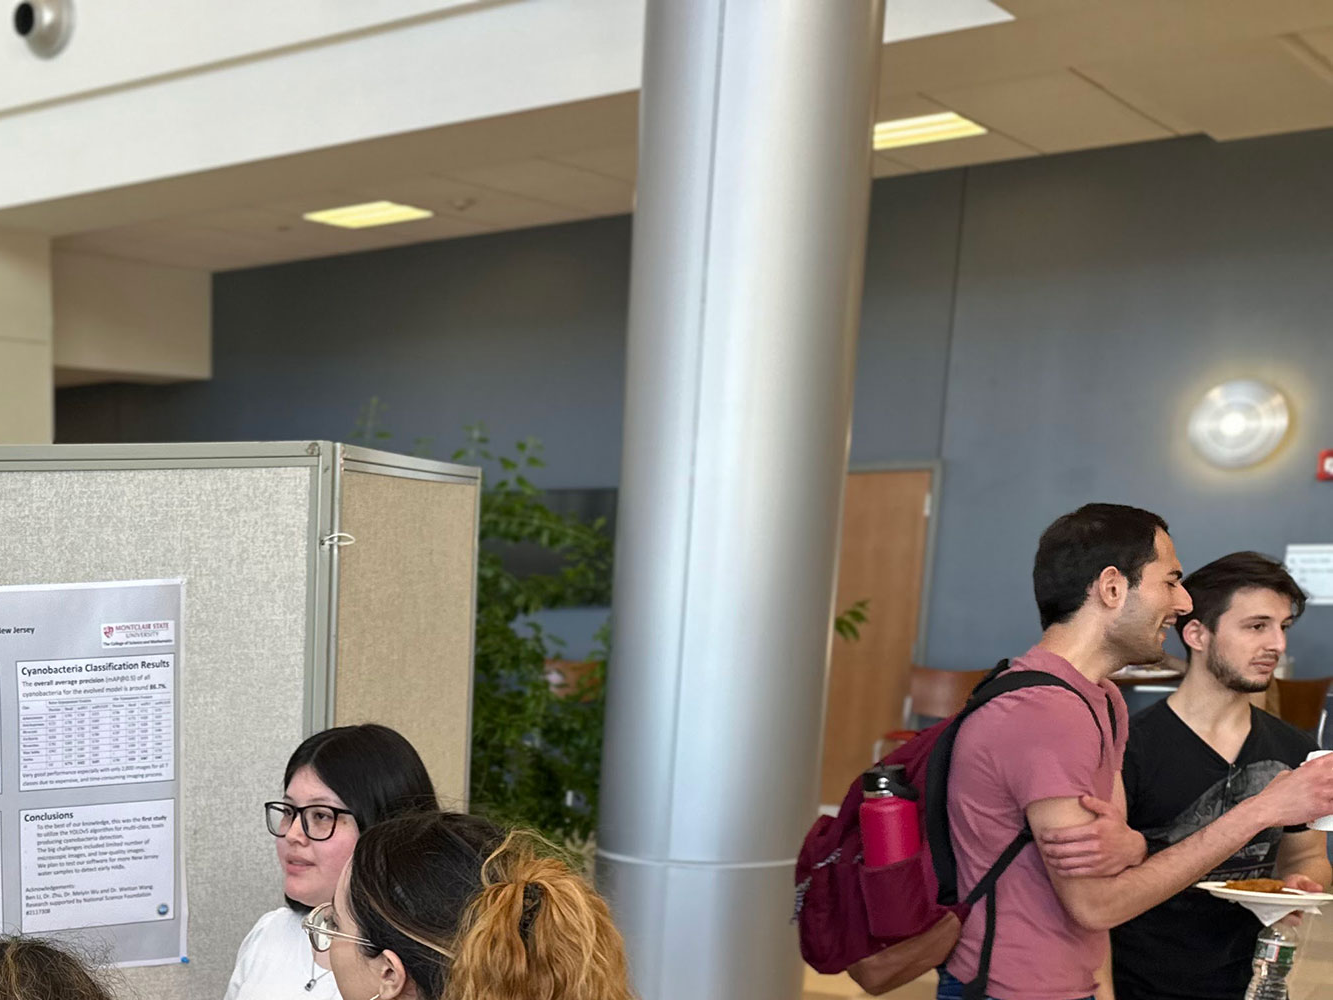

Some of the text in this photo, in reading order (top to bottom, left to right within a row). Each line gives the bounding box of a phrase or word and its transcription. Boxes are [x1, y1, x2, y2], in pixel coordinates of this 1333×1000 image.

[12, 627, 35, 636] Jersey
[21, 659, 170, 677] Cyanobacteria Classification Results
[78, 677, 104, 685] precision
[24, 811, 73, 822] Conclusions
